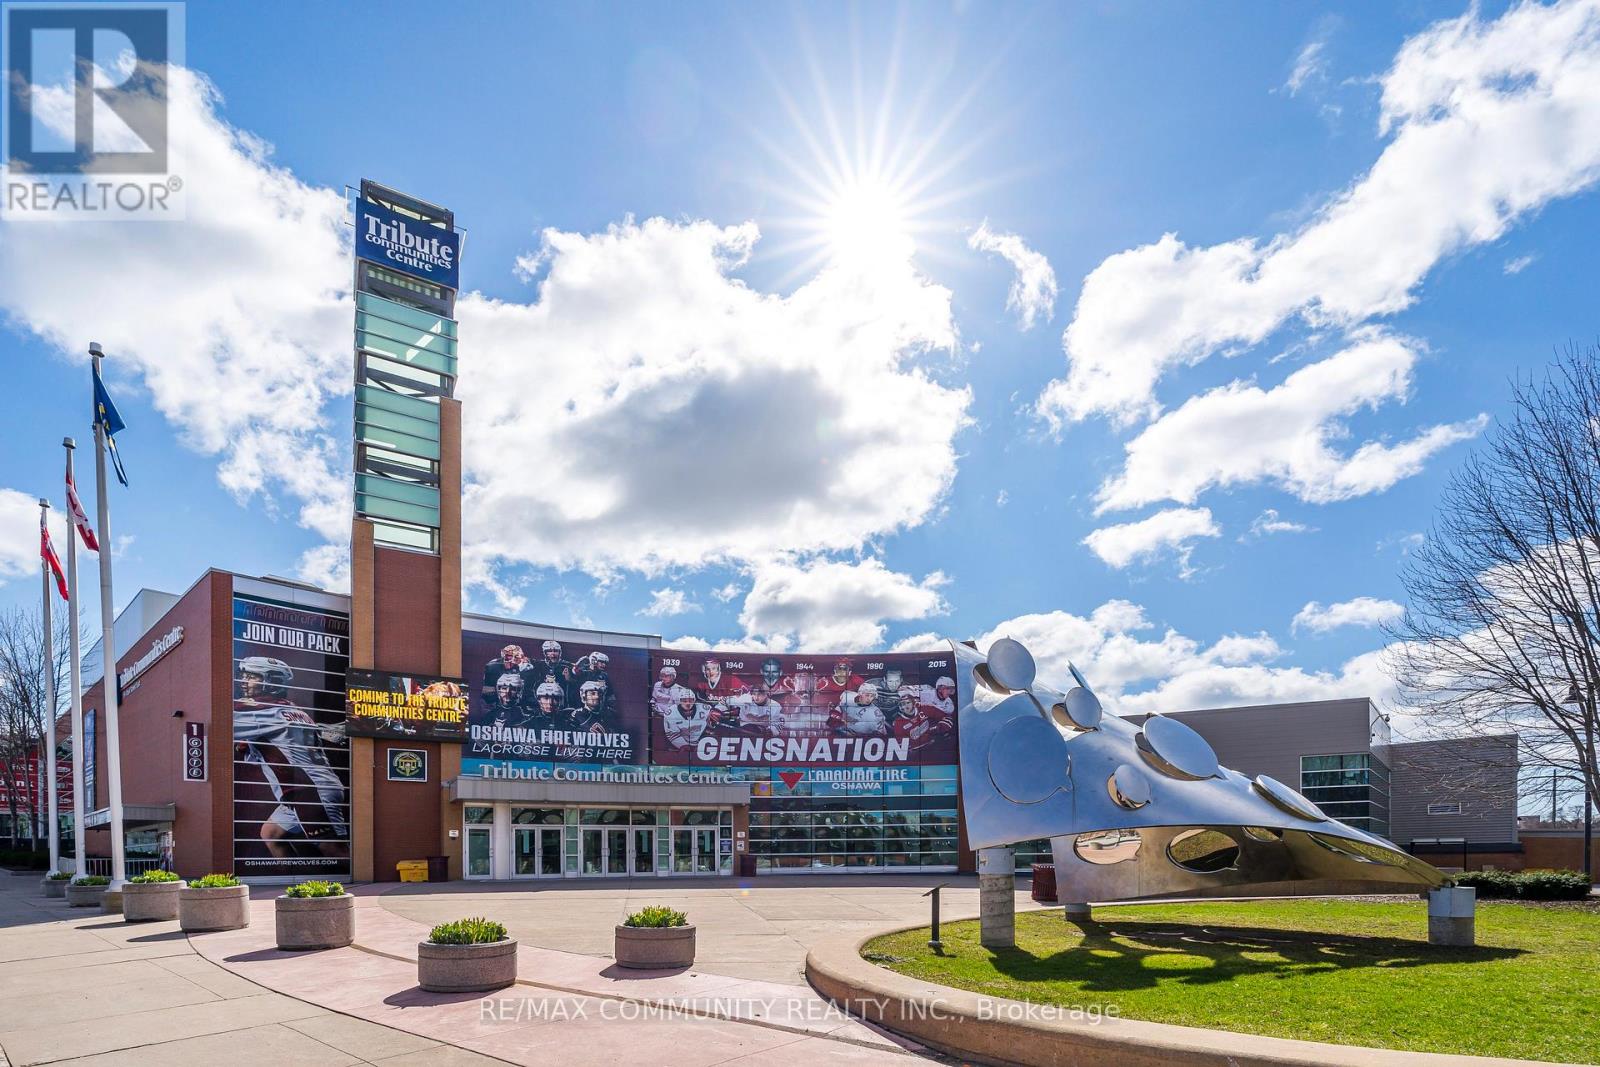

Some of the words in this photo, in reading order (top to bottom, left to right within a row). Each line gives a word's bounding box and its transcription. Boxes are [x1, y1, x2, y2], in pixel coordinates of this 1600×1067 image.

[364, 213, 453, 261] Tribute
[386, 249, 433, 272] Centre
[242, 623, 275, 643] JOIN
[279, 629, 304, 648] OUR
[308, 633, 341, 653] PACK
[663, 658, 681, 666] 1939
[725, 661, 744, 669] 1940
[928, 660, 947, 668] 2015
[349, 689, 389, 705] COMING
[391, 692, 404, 705] TO
[408, 694, 425, 706] THE
[428, 695, 466, 710] TRIBUTE
[354, 704, 424, 720] COMMUNITIES
[426, 709, 462, 723] CENTRE
[191, 724, 198, 736] 1
[471, 724, 537, 743] OSHAWA
[472, 743, 550, 756] LACROSSE
[555, 747, 594, 758] LIVES
[596, 749, 632, 759] HERE
[696, 737, 910, 761] GENSNATION
[480, 762, 550, 780] Tribute
[553, 766, 673, 784] Communities
[677, 770, 734, 785] Centre
[879, 768, 908, 780] TIRE
[831, 782, 881, 790] OSHAWA
